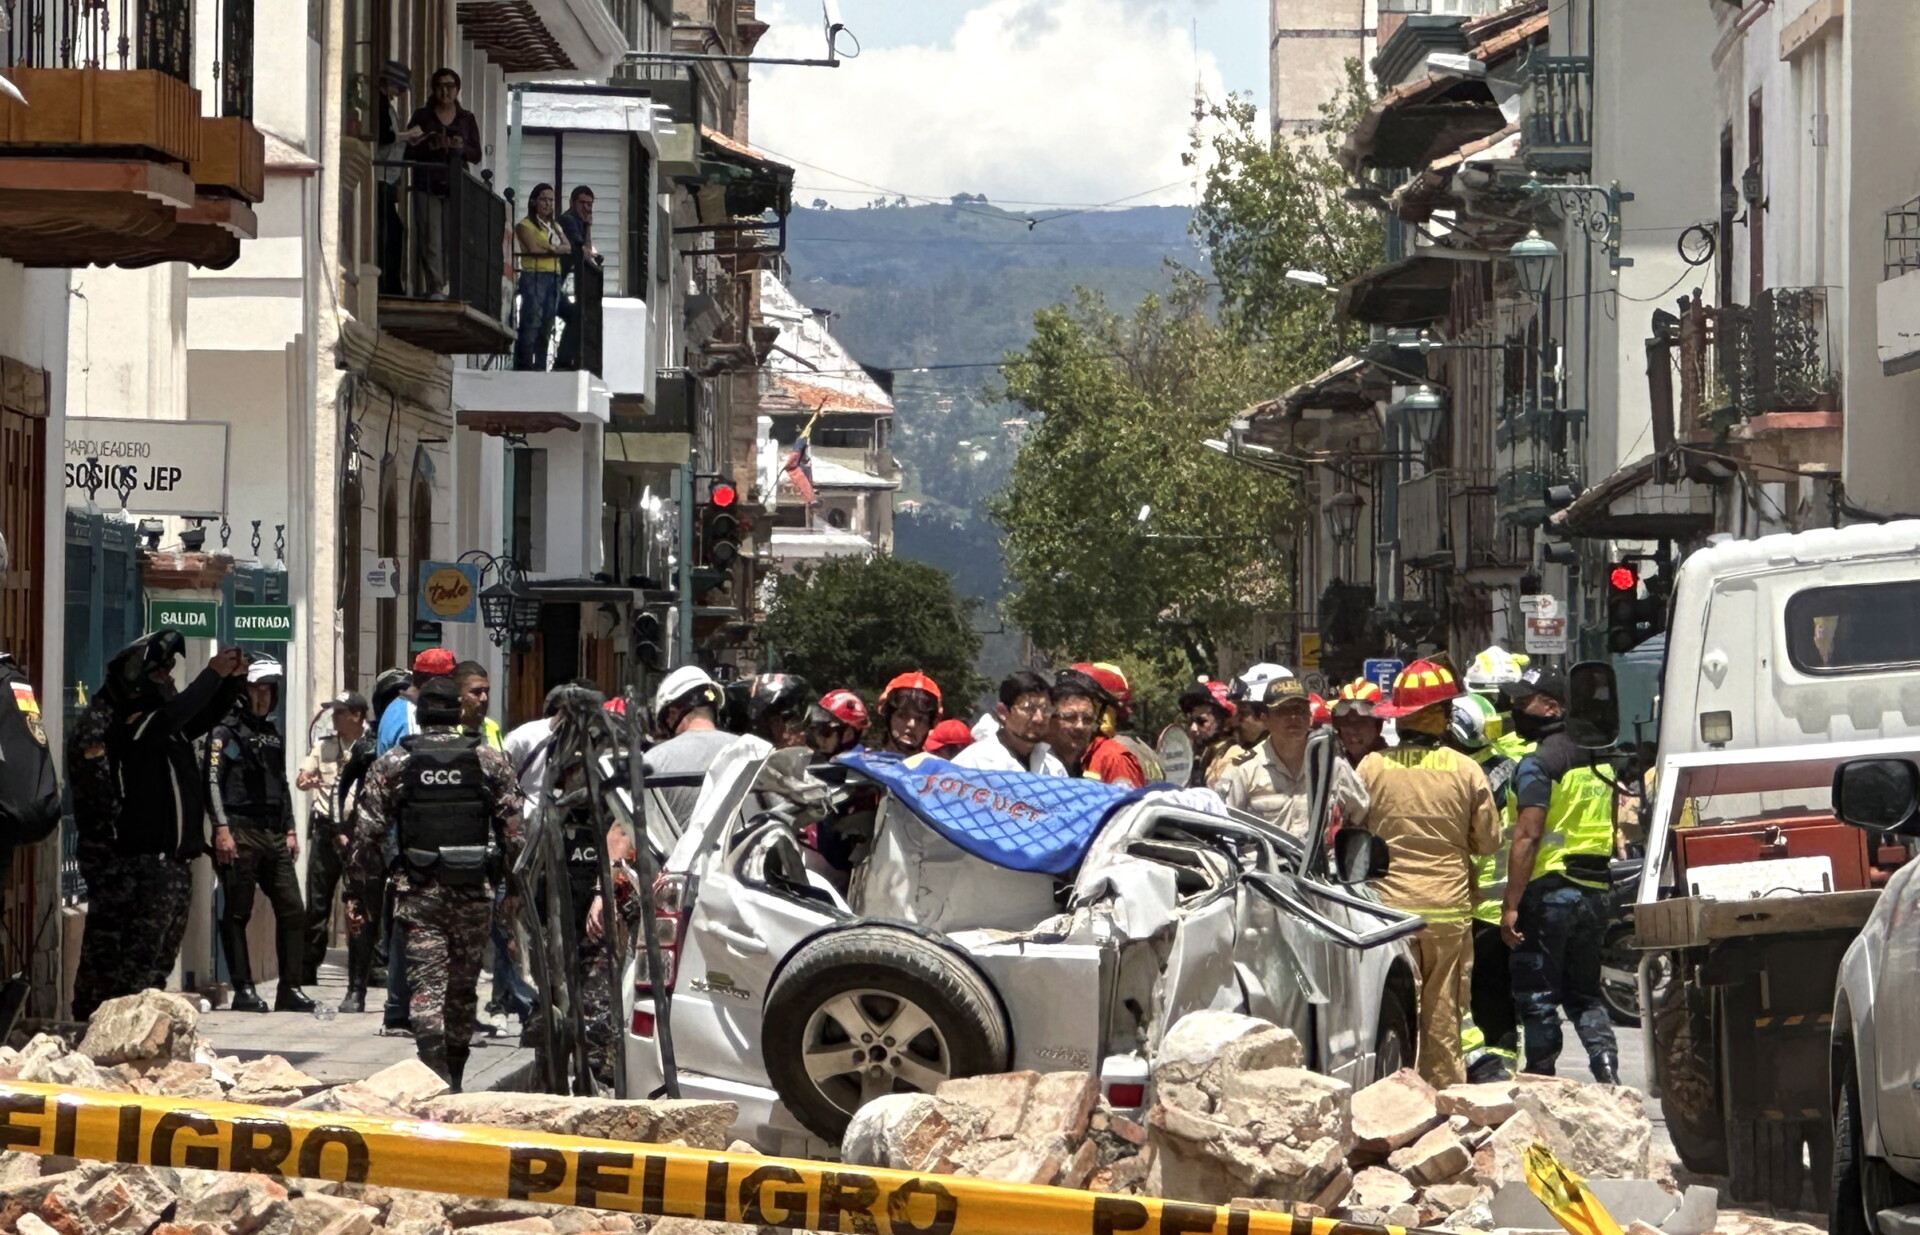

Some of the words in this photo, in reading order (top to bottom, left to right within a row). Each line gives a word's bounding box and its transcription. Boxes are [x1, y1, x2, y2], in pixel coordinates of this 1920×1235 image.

[65, 440, 151, 458] PARQUEADERO
[144, 466, 182, 491] JEP
[160, 612, 207, 626] SALIDA
[234, 616, 290, 628] ENTRADA
[420, 769, 462, 785] GCC
